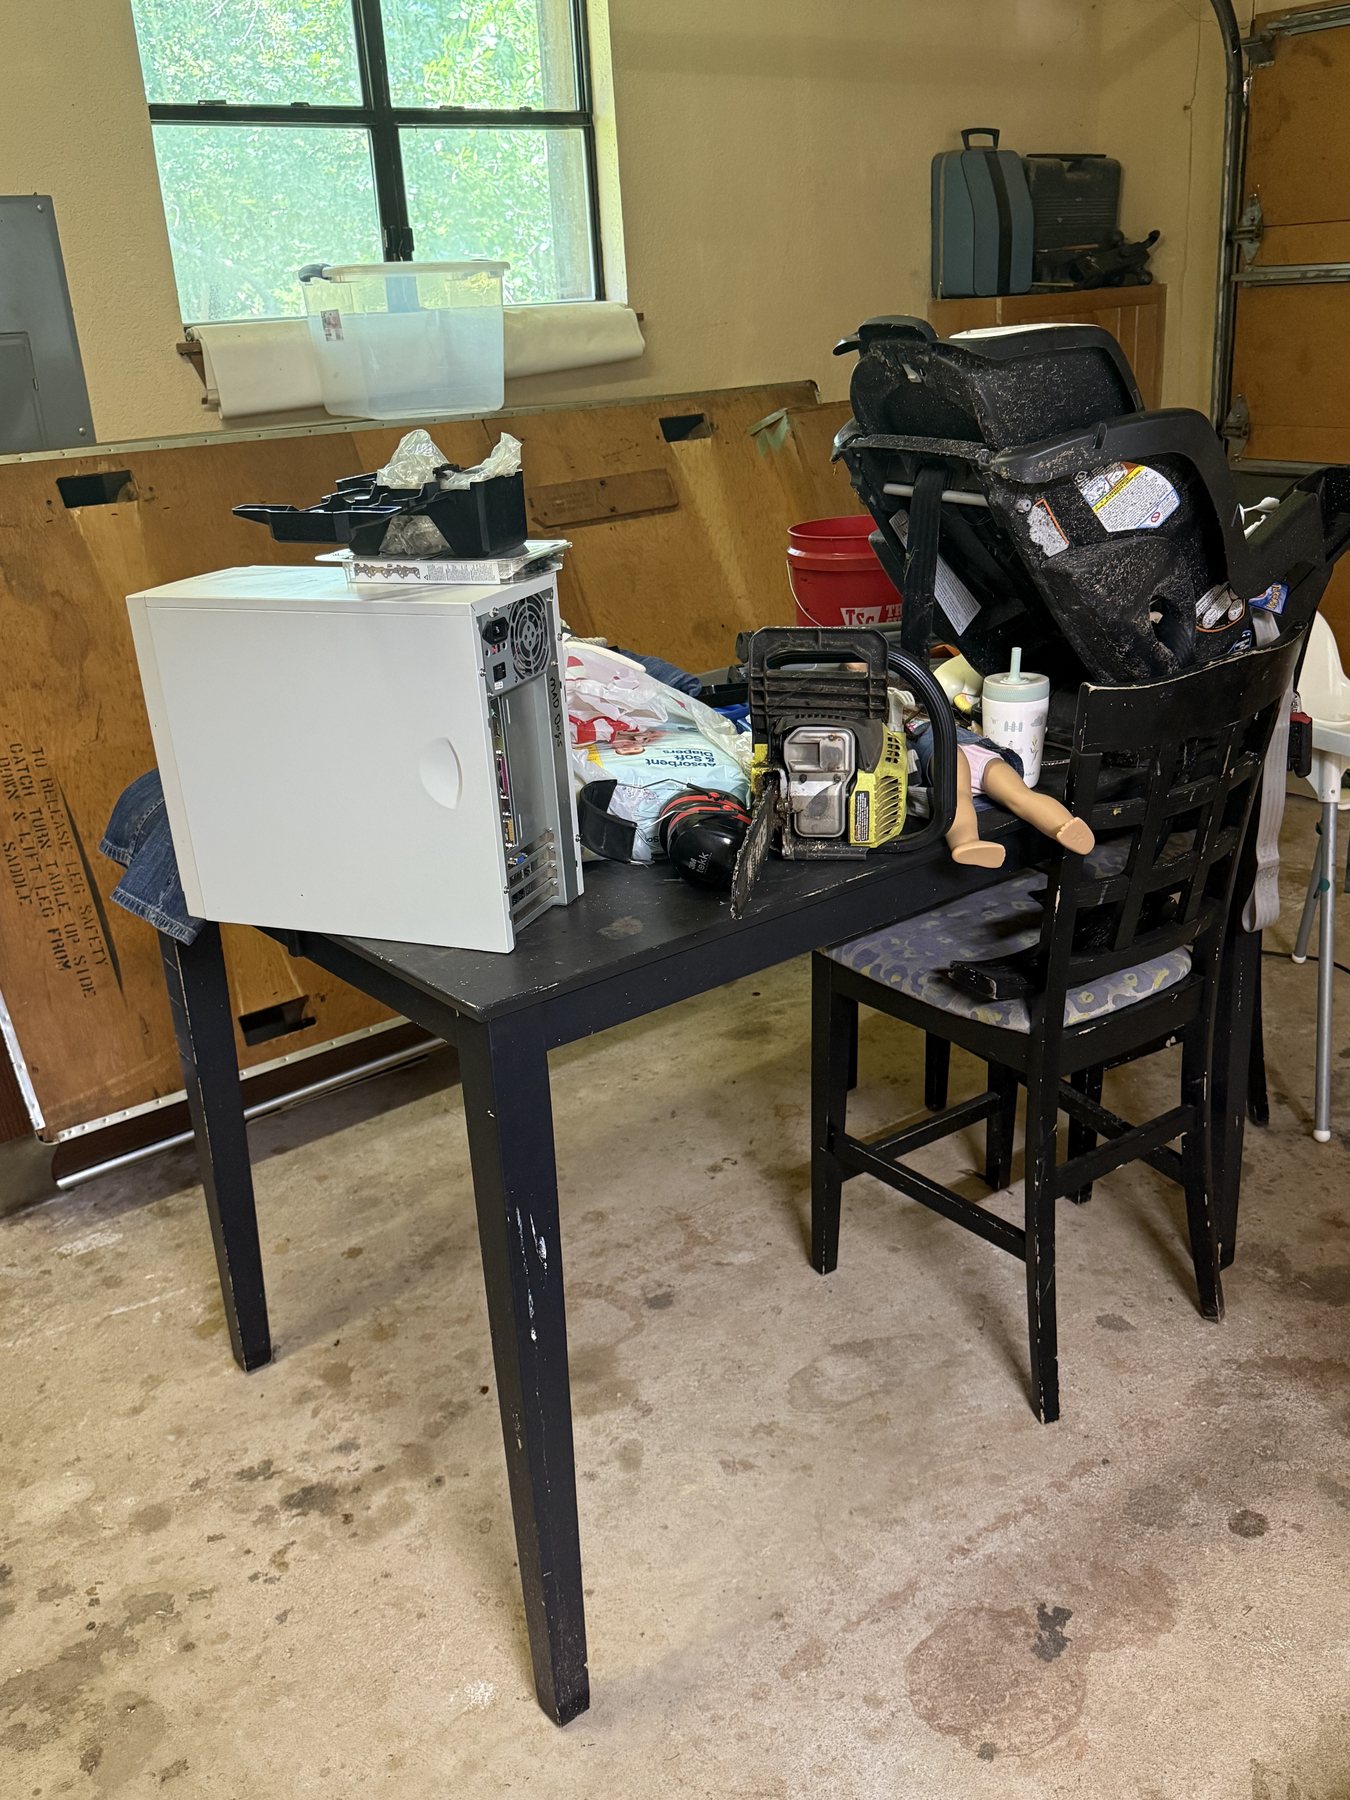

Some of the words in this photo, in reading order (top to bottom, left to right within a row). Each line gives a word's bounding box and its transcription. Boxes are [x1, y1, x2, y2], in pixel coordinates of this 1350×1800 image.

[31, 747, 48, 768] TO
[645, 758, 717, 767] Absorbent
[662, 749, 714, 757] Diapers
[39, 777, 73, 850] RELEASE
[0, 757, 19, 800] DOWN
[19, 831, 43, 874] LIFT
[34, 885, 56, 918] LEG
[47, 928, 72, 971] FROM
[2, 842, 33, 906] SADDLE
[9, 742, 36, 798] CATCH
[29, 807, 52, 850] TURN
[45, 860, 72, 915] TABLE
[63, 923, 80, 947] UP
[72, 953, 97, 999] SIDE
[64, 862, 86, 895] LEG
[79, 905, 109, 966] SAFETY
